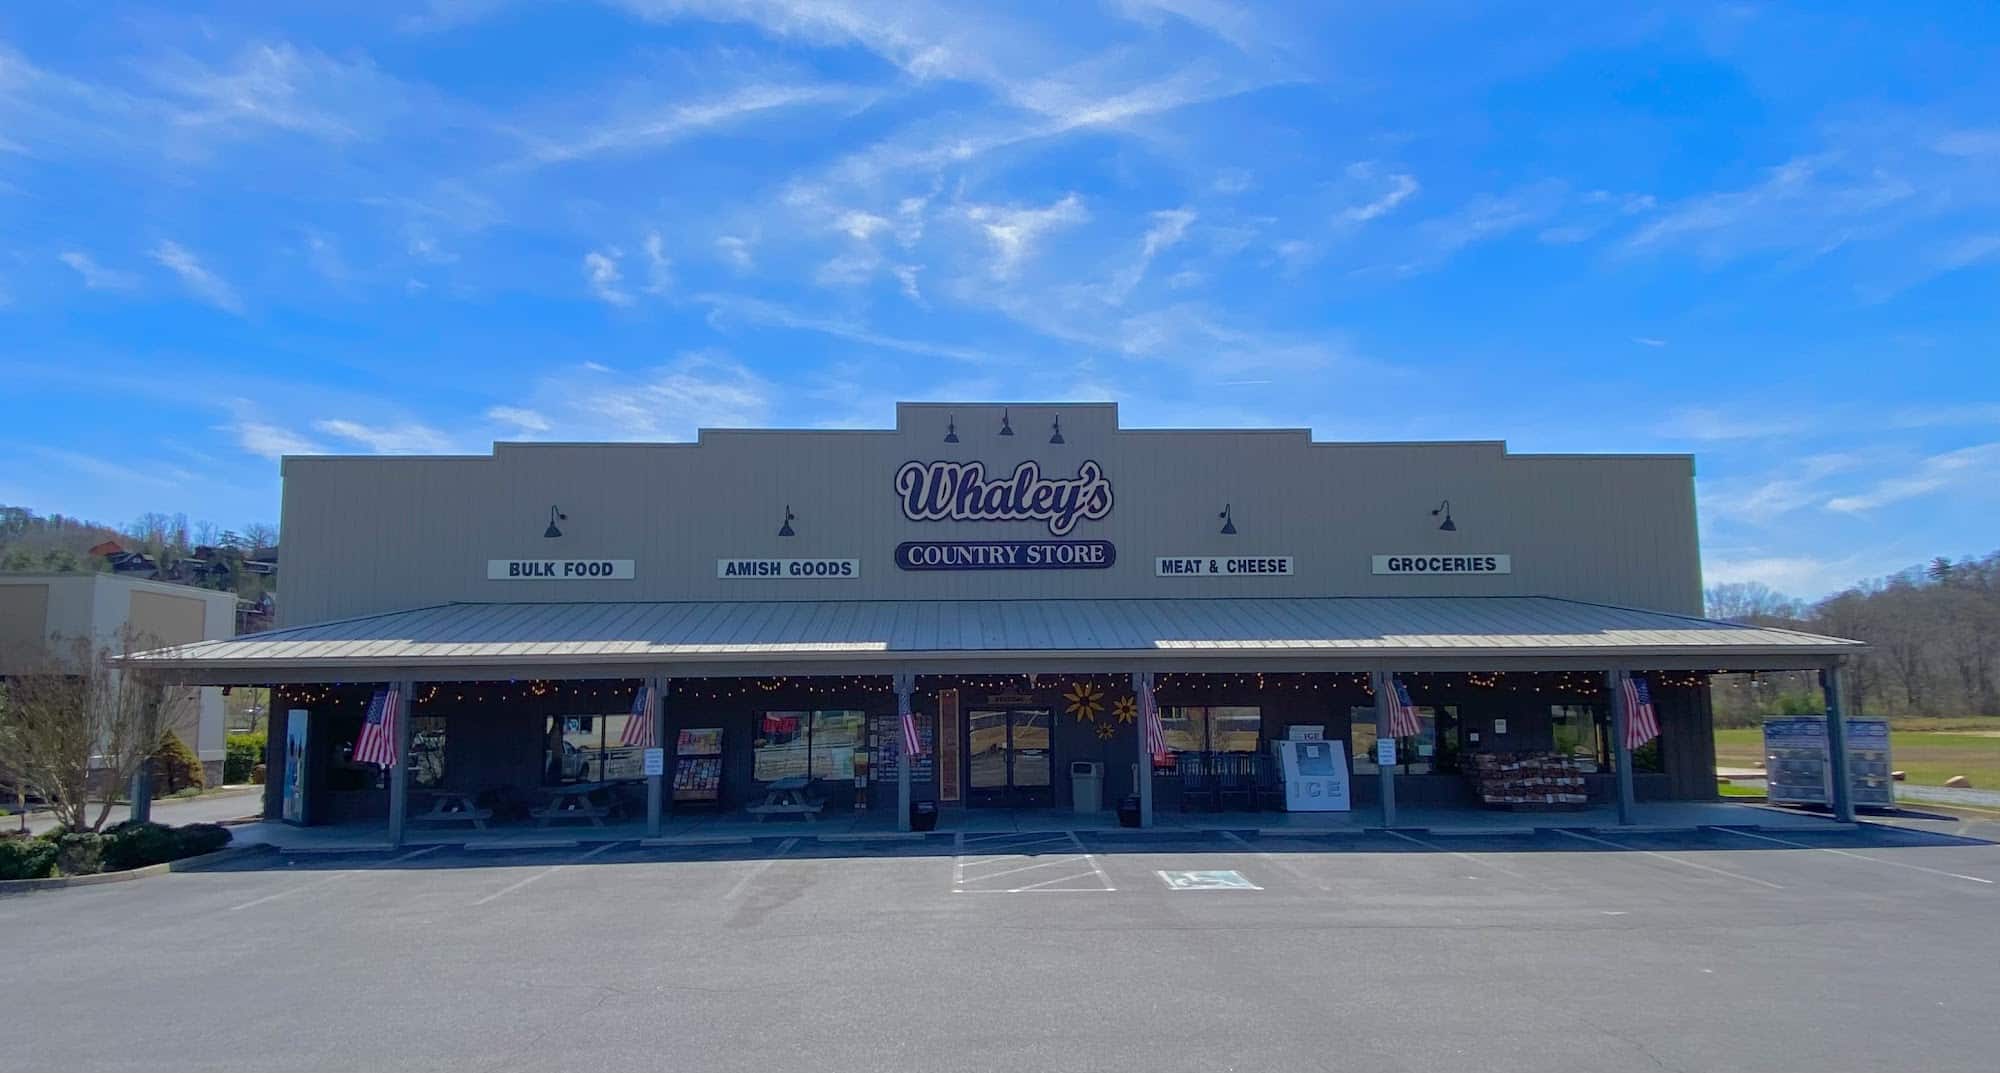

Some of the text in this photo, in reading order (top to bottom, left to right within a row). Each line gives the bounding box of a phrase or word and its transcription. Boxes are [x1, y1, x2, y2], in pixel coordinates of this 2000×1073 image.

[897, 462, 1111, 534] Whaley's
[907, 545, 1105, 565] COUNTRY STORE
[508, 562, 614, 577] BULK FOOD
[725, 560, 852, 576] AMISH GOODS
[1161, 559, 1287, 574] MEAT & CHEESE
[1388, 557, 1497, 571] GROCERIES
[1303, 732, 1321, 741] ICE
[1294, 780, 1342, 799] ICE
